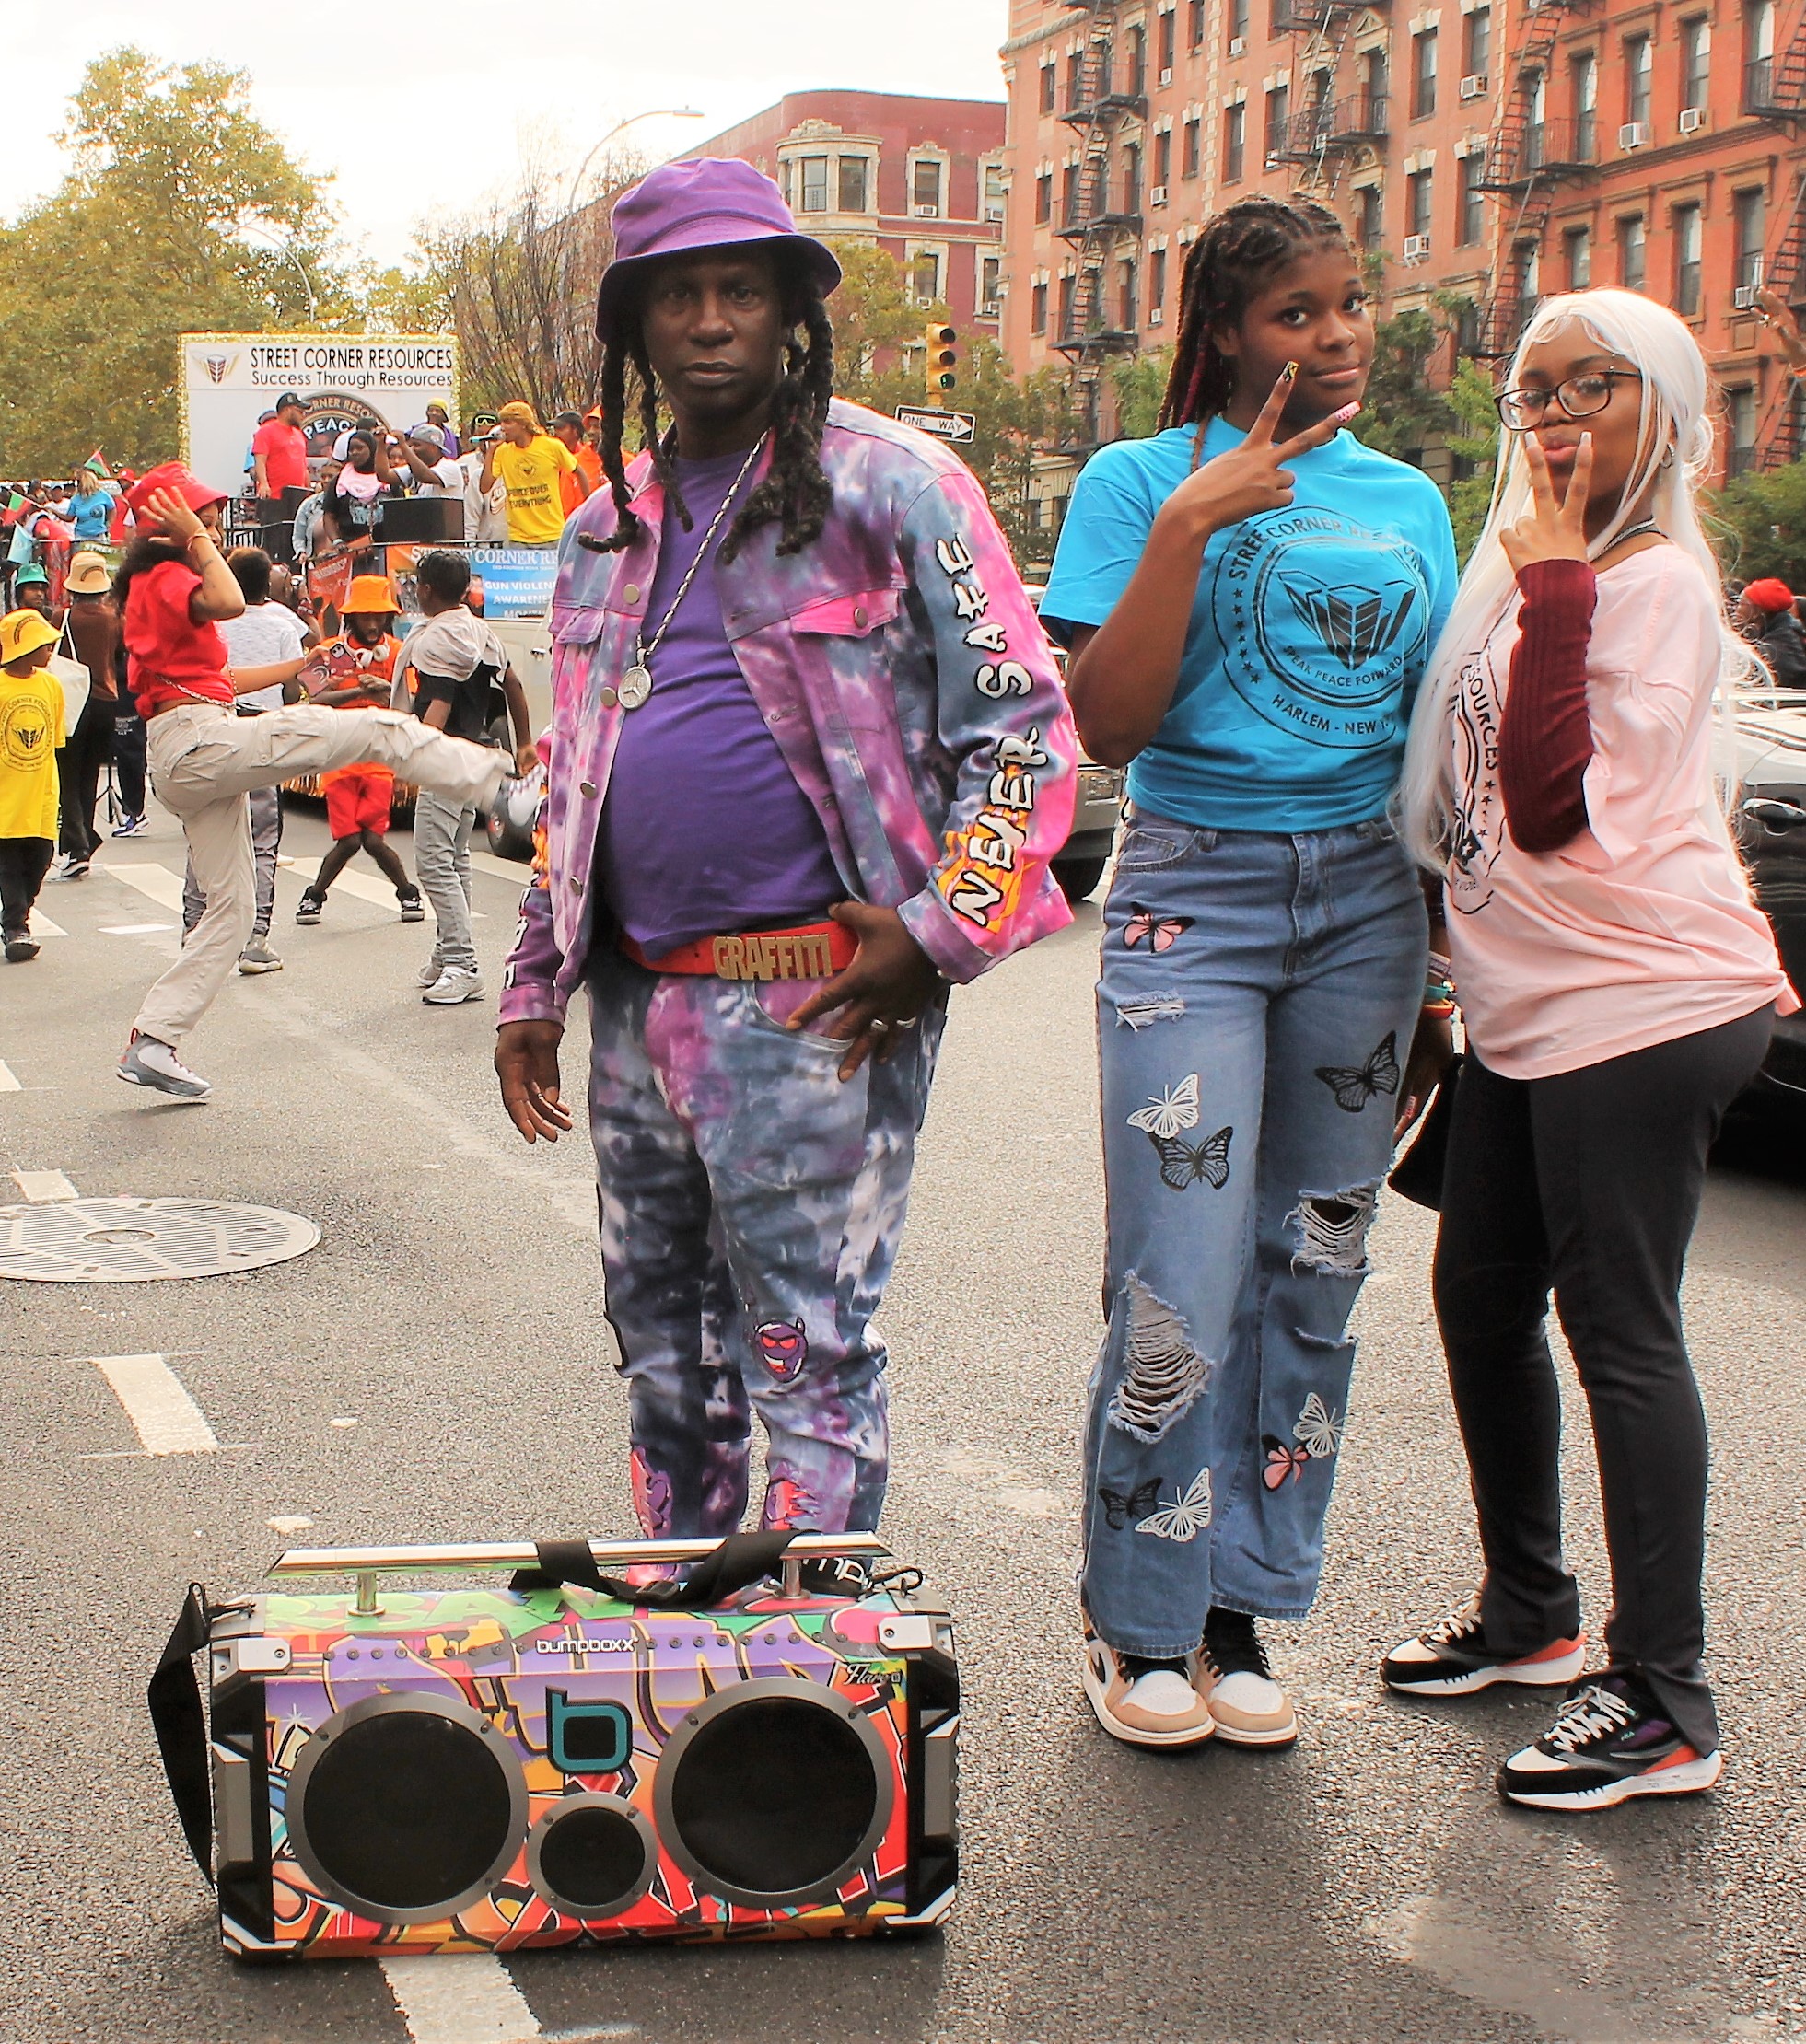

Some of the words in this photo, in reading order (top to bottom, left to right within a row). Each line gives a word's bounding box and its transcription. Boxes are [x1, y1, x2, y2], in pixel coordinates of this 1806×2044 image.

[251, 348, 298, 368] STREET
[304, 348, 364, 368] CORNER
[369, 348, 452, 369] RESOURCES
[251, 371, 311, 386] Success
[317, 371, 375, 389] Through
[379, 372, 452, 386] Resources
[302, 417, 351, 440] PEAC
[903, 415, 926, 427] ONE
[939, 419, 963, 433] WAY
[475, 549, 538, 564] CORNER
[1228, 528, 1269, 581] STREE
[1265, 516, 1342, 538] CORNER
[484, 581, 509, 590] GUN
[511, 581, 555, 590] VIOLEN
[493, 595, 553, 604] AWARENE
[935, 532, 1032, 701] SAFE
[1282, 645, 1315, 675] SPEAK
[1314, 670, 1352, 687] PEACE
[1271, 693, 1331, 732] HARLEM
[1344, 720, 1378, 734] NEW
[951, 726, 1048, 927] NEVER
[713, 933, 833, 981] GRAFFITI
[536, 1638, 635, 1655] bumpboxx
